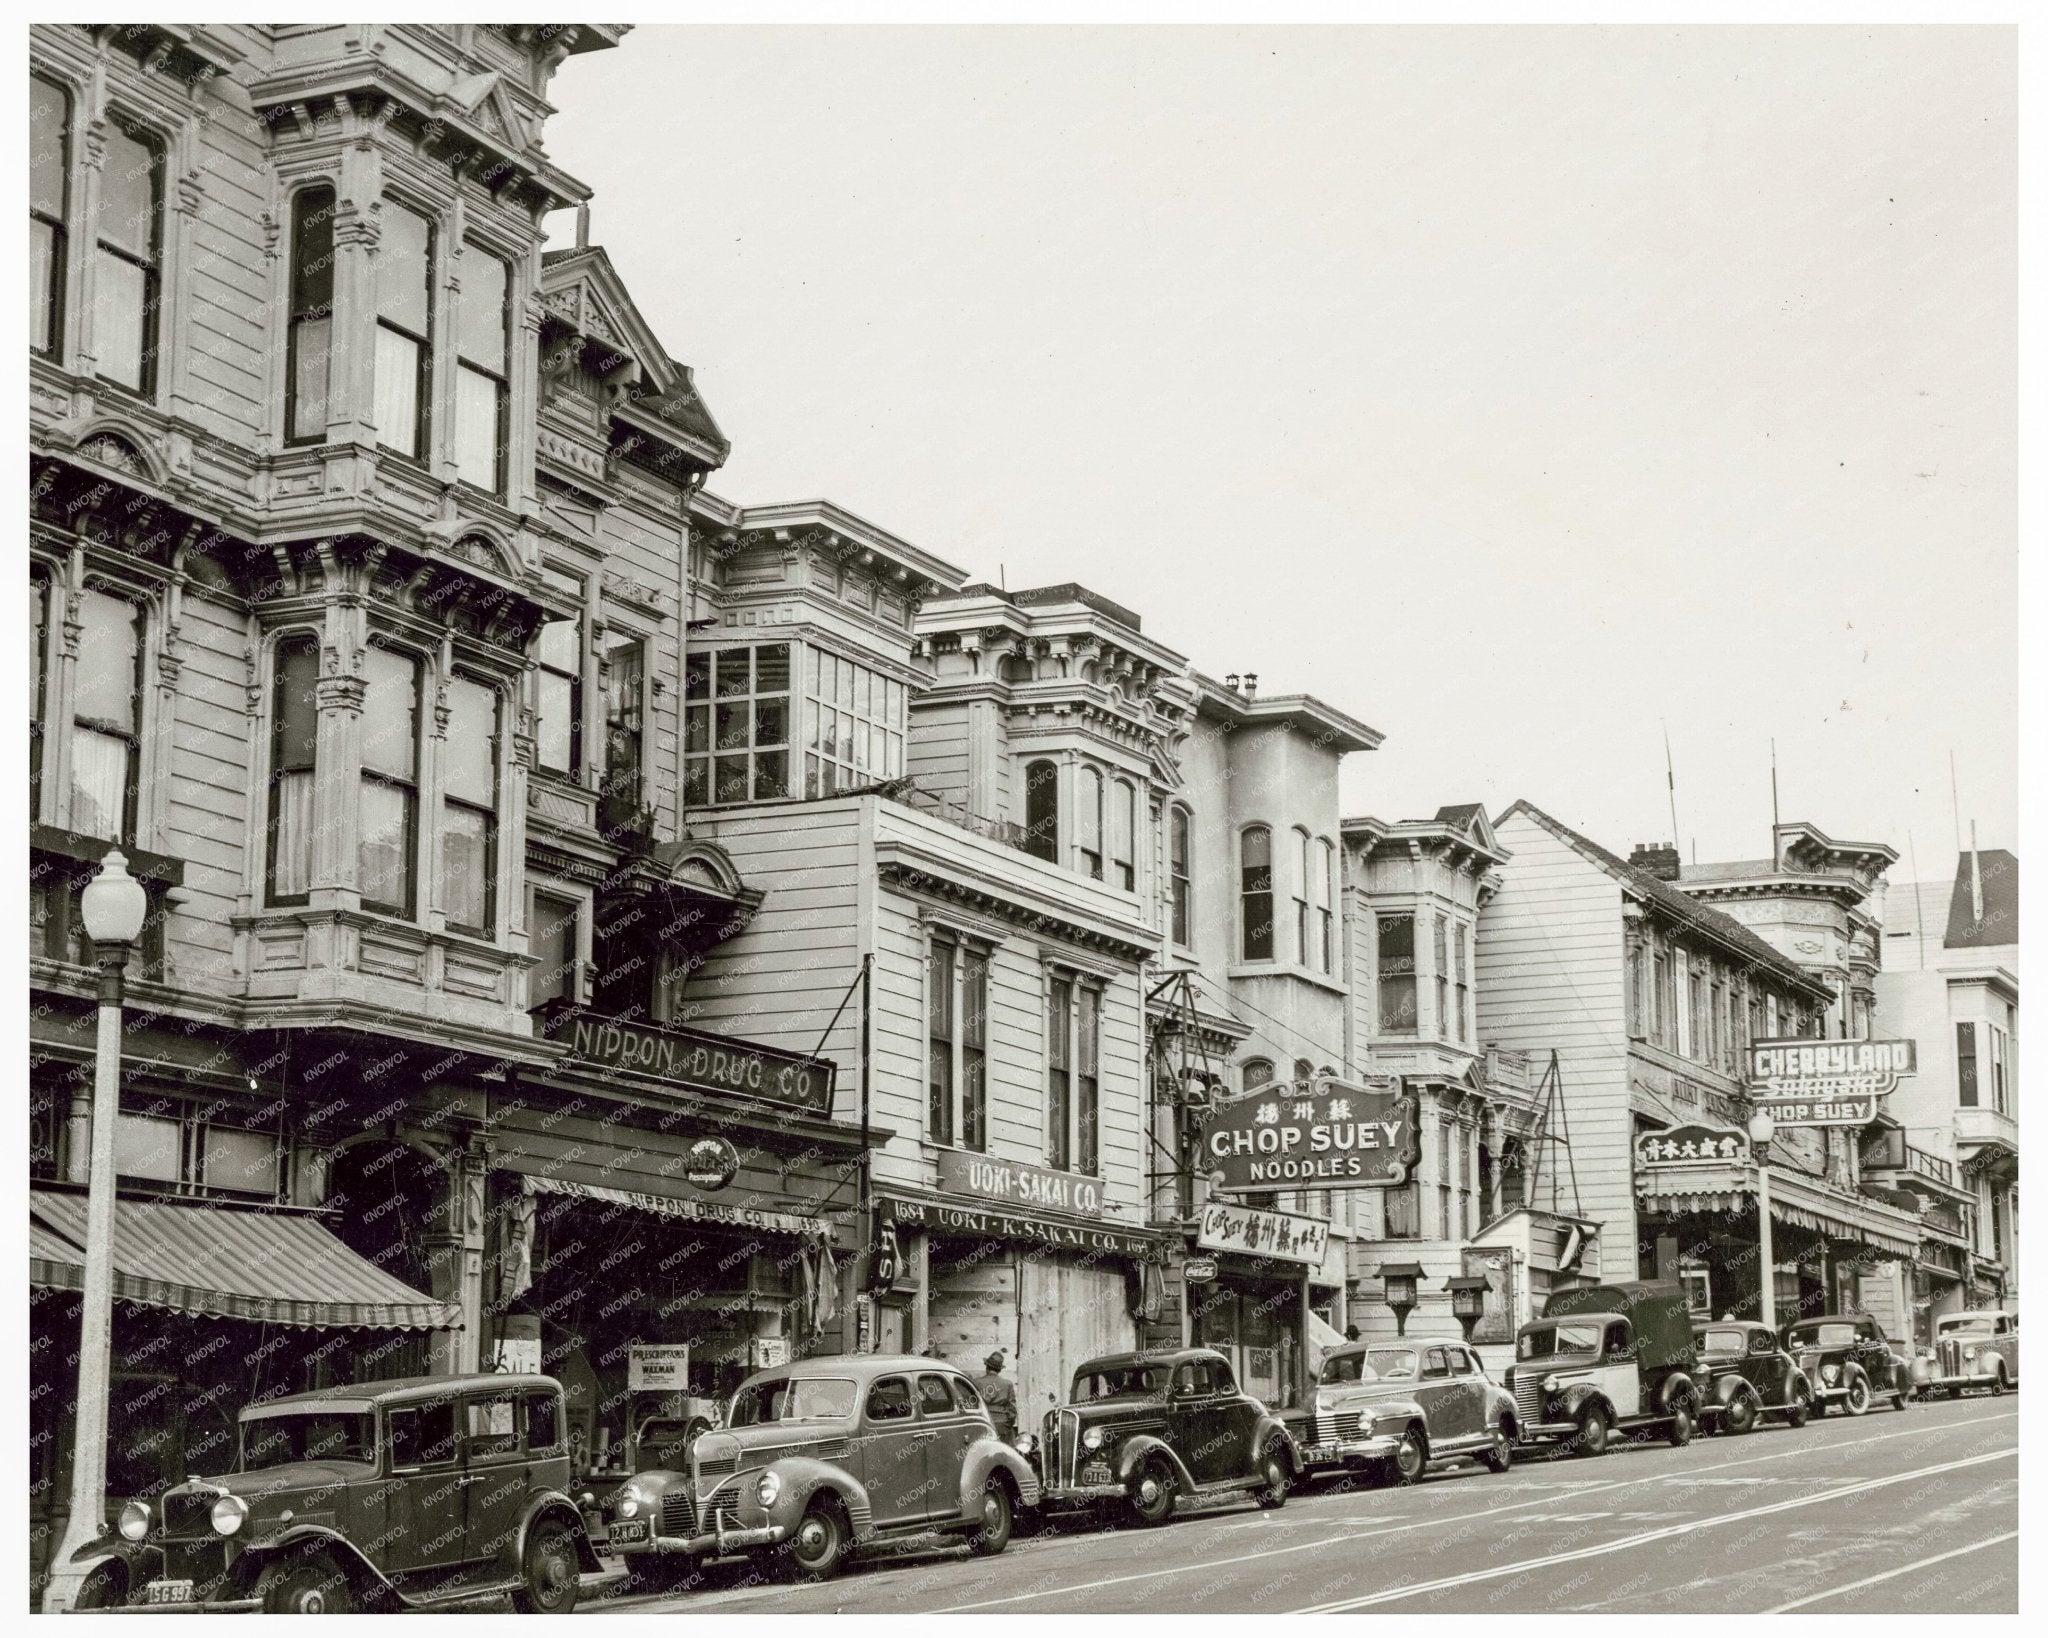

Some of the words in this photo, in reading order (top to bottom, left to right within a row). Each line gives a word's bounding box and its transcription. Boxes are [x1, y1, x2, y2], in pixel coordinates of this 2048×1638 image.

[573, 1020, 675, 1070] NIPPON
[692, 1047, 762, 1089] DRUG
[1755, 1043, 1909, 1077] CHERRYLAND
[1813, 1102, 1868, 1120] SUEY
[1210, 1126, 1302, 1157] CHOP
[1310, 1120, 1402, 1152] SUEY
[969, 1162, 1069, 1207] UOKI-SAKAI
[1250, 1157, 1362, 1184] NOODLES
[744, 1210, 764, 1225] CO.
[938, 1208, 987, 1230] UOKI
